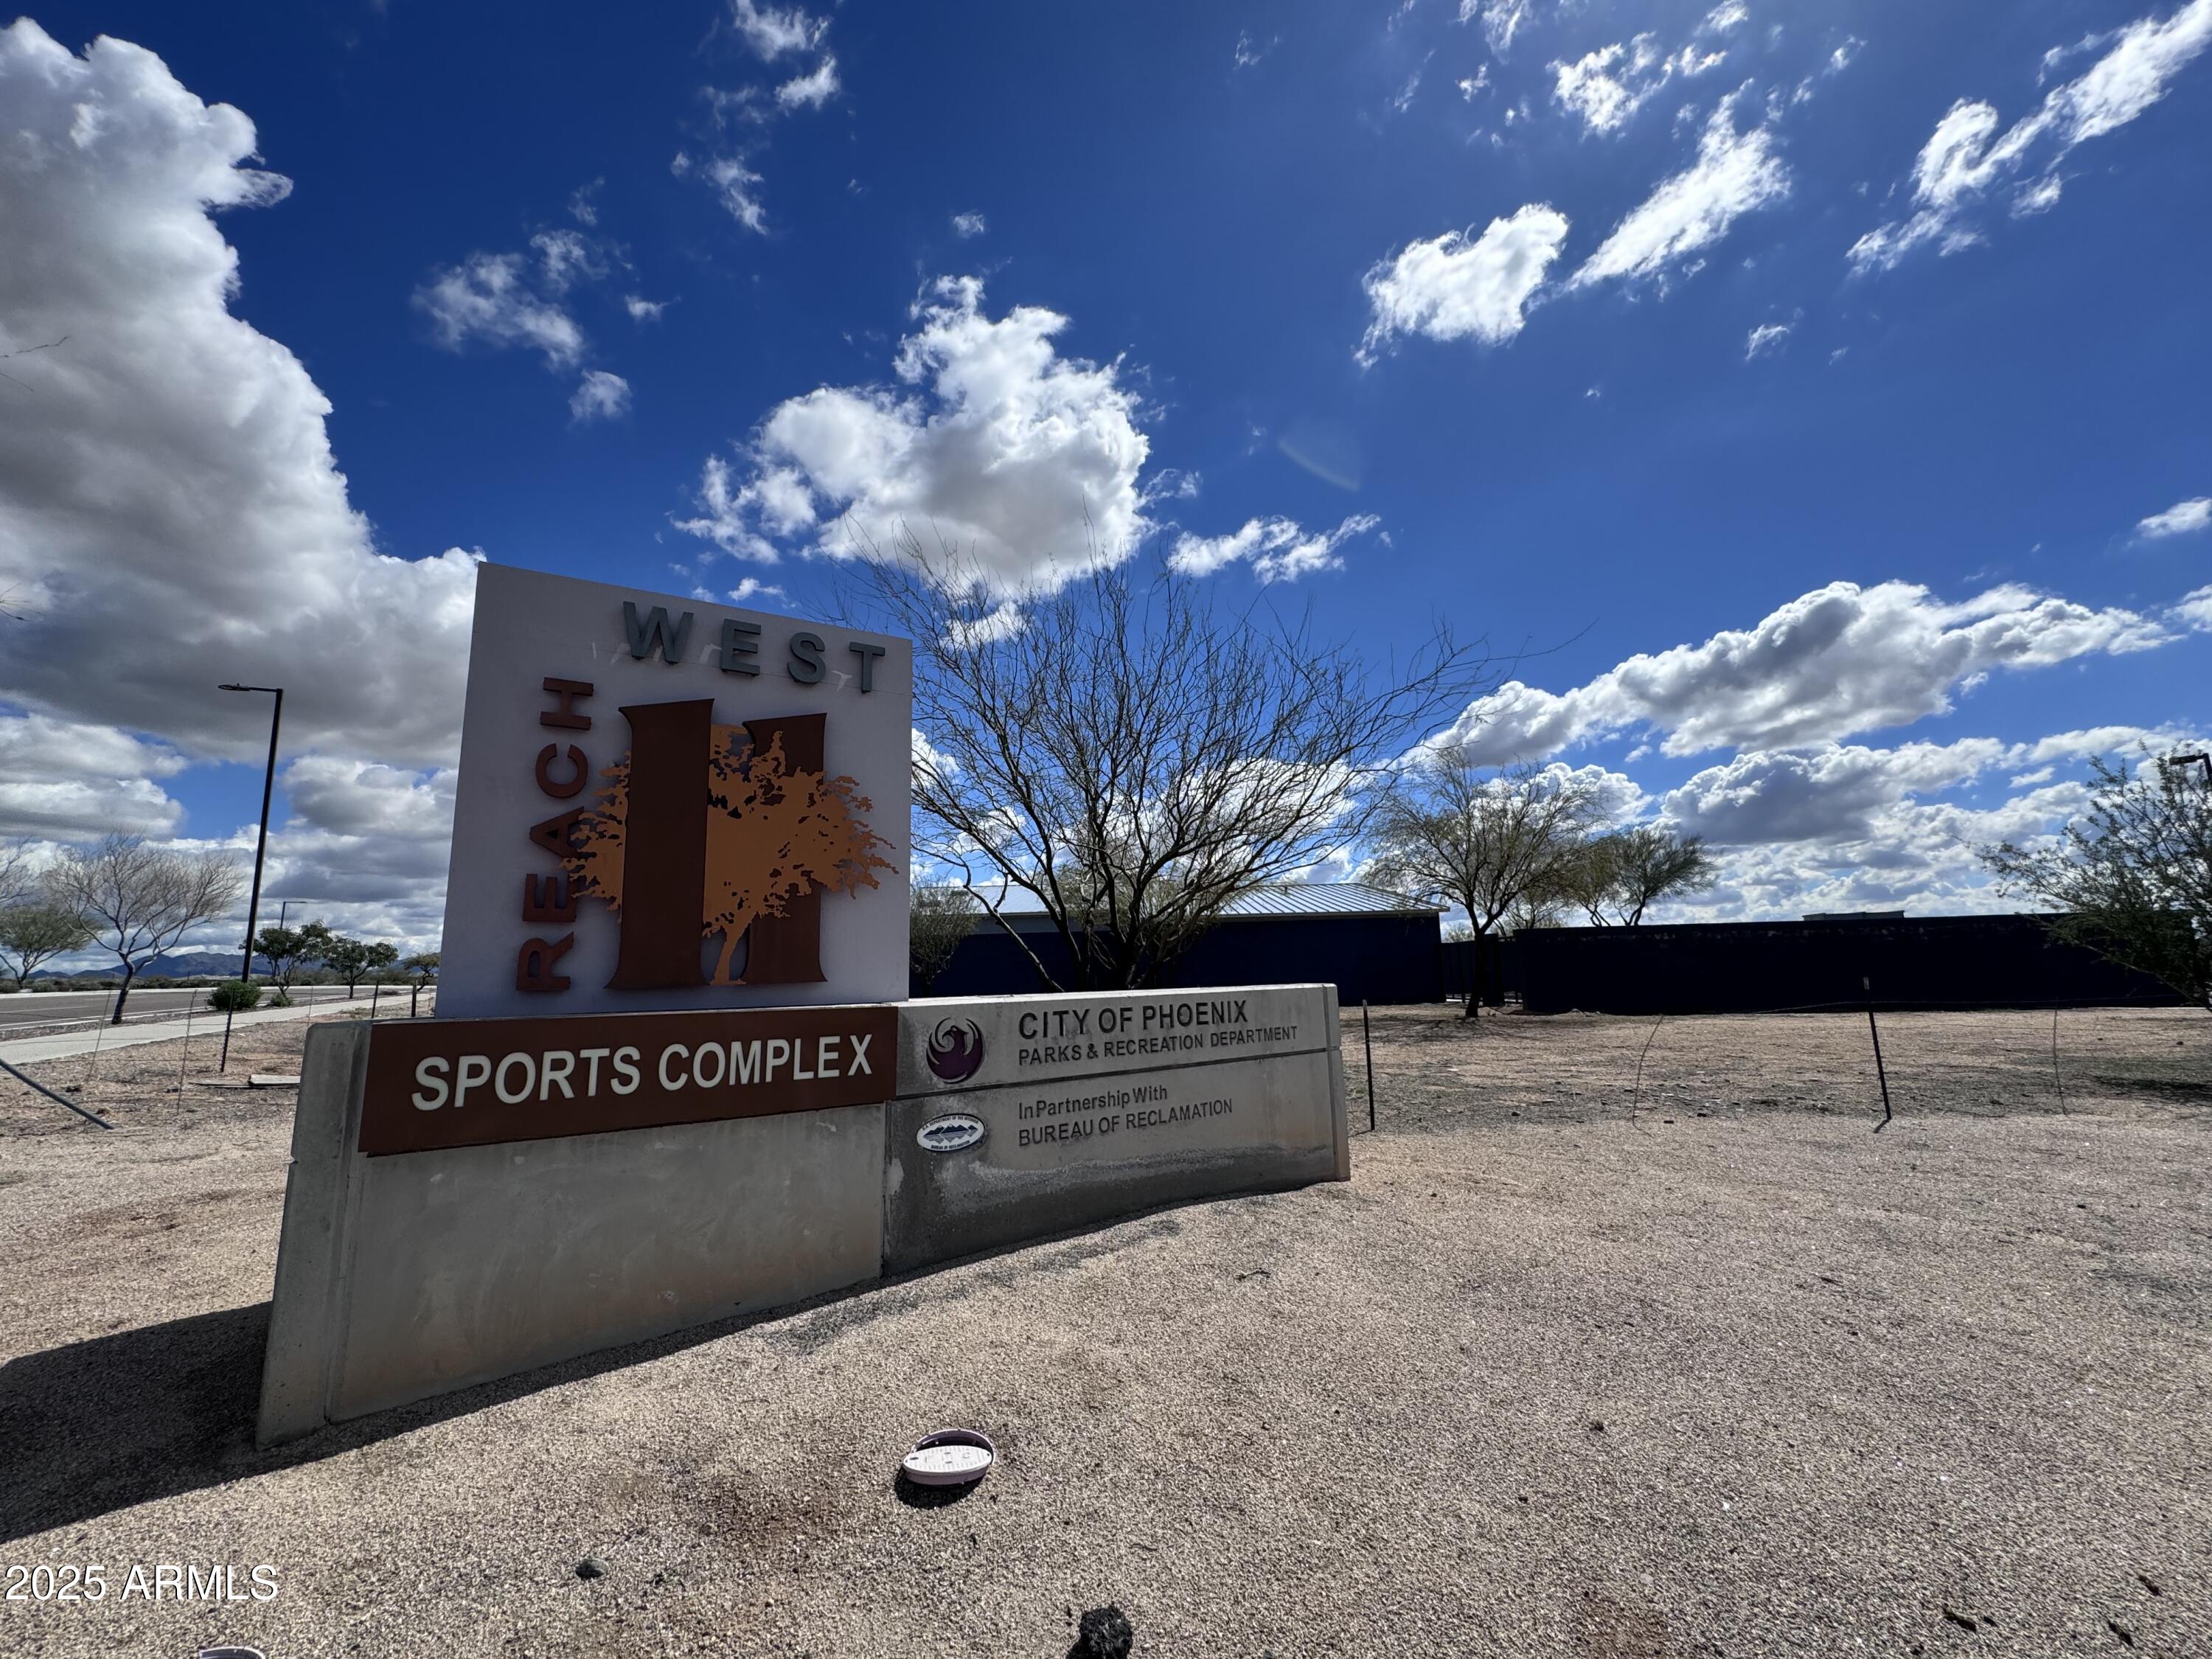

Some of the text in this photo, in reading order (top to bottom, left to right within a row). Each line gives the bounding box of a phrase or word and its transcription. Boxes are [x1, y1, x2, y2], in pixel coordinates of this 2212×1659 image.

[622, 601, 885, 694] WEST
[516, 677, 594, 991] REACH
[603, 698, 827, 990] 11
[1019, 1000, 1248, 1040] CITY OF PHOENIX
[1019, 1026, 1298, 1065] PARKS & RECREATION DEPARTMENT
[411, 1034, 874, 1111] SPORTS COMPLEX
[1036, 1091, 1130, 1118] Partnership
[1133, 1085, 1167, 1103] With
[1019, 1098, 1233, 1147] BUREAU OF RECLAMATION
